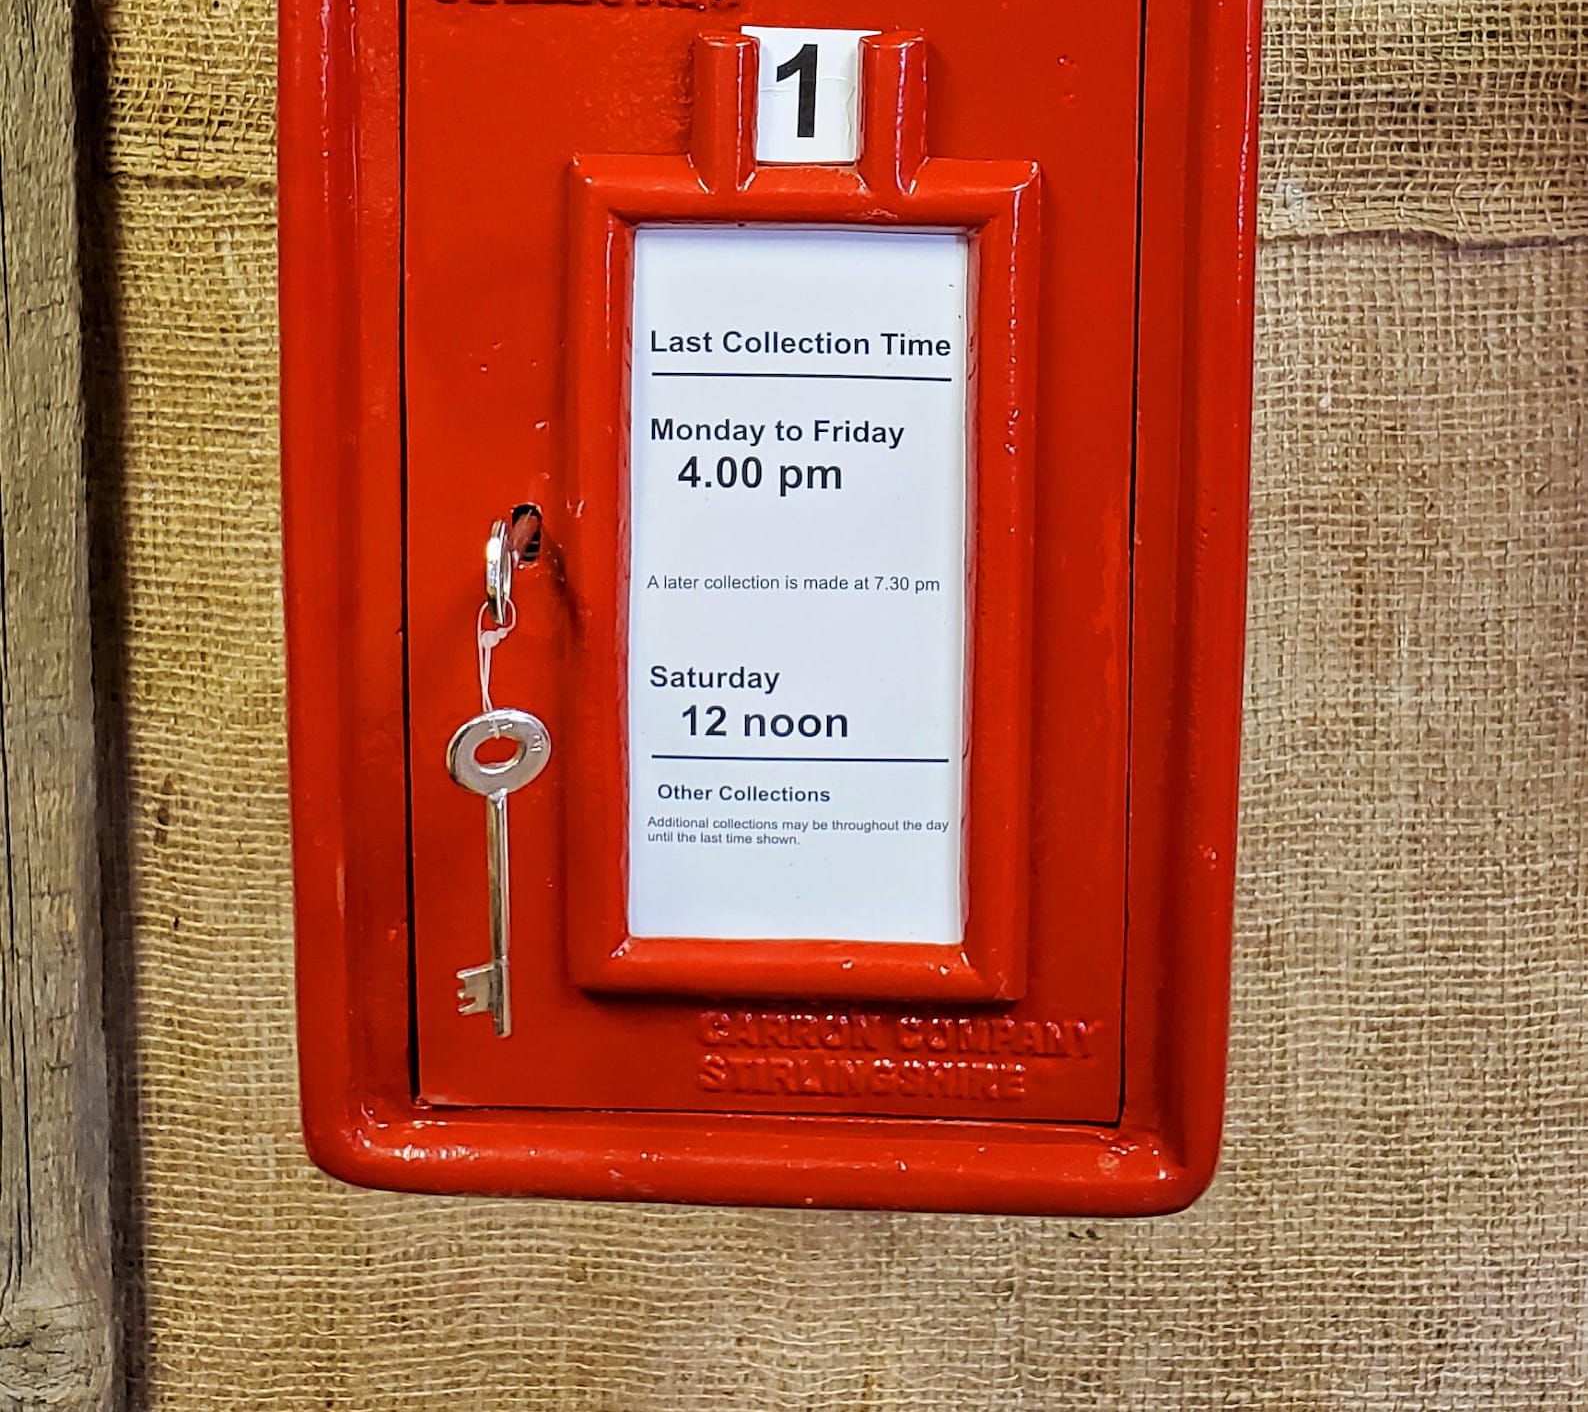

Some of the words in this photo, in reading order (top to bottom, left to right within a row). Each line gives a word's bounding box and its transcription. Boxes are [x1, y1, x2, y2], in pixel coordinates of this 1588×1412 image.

[776, 43, 818, 138] 1
[651, 330, 713, 353] Last
[722, 330, 870, 355] Collection
[880, 332, 952, 357] Time
[651, 418, 766, 447] Monday
[775, 420, 803, 442] to
[814, 419, 905, 449] Friday
[677, 455, 763, 489] 4.00
[779, 464, 842, 497] pm
[646, 574, 660, 589] A
[663, 574, 700, 590] later
[704, 574, 780, 590] collection
[785, 575, 798, 590] is
[803, 575, 849, 591] made
[853, 576, 870, 591] at
[874, 576, 910, 591] 7.30
[915, 580, 940, 594] pm
[649, 665, 780, 695] Saturday
[682, 704, 727, 737] 12
[744, 712, 848, 738] noon
[657, 784, 713, 801] Other
[719, 785, 831, 803] Collections
[647, 816, 709, 829] Additional
[712, 817, 778, 830] collections
[782, 820, 809, 833] may
[812, 819, 828, 831] be
[831, 819, 899, 833] throughout
[902, 819, 923, 831] the
[926, 819, 949, 833] day
[647, 831, 674, 843] until
[677, 832, 697, 843] the
[700, 832, 722, 844] last
[725, 833, 753, 844] time
[756, 834, 800, 845] shown.
[700, 1012, 880, 1051] CARRON
[898, 1016, 1102, 1058] COMPANY
